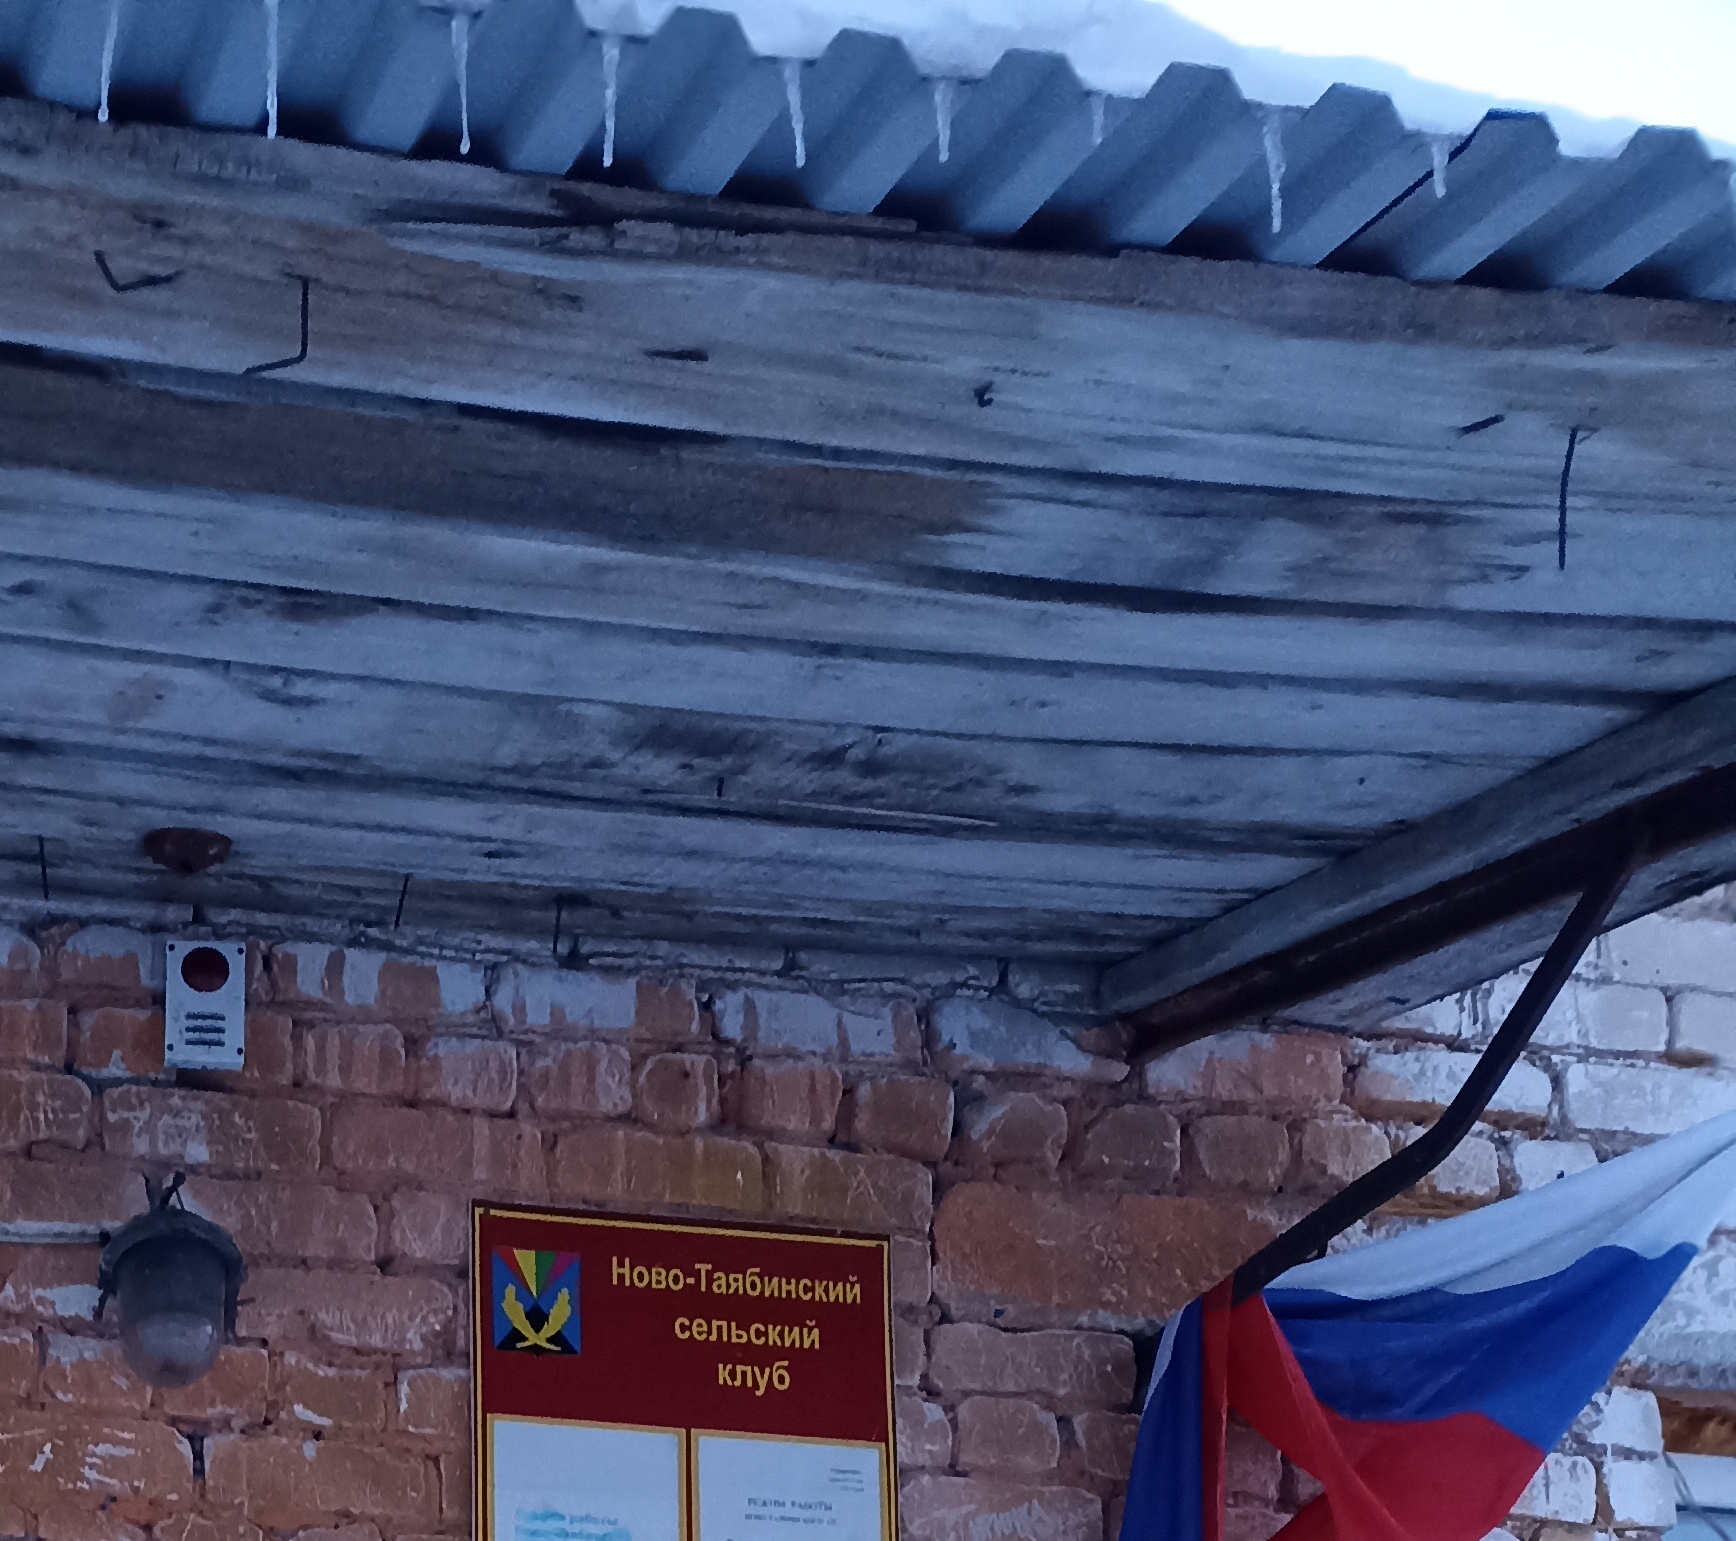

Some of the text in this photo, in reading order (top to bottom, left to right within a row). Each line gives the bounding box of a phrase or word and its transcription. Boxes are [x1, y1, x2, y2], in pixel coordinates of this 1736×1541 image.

[612, 1256, 862, 1304] Ново-Таябинский
[674, 1315, 820, 1350] сельский
[718, 1361, 791, 1396] клуб
